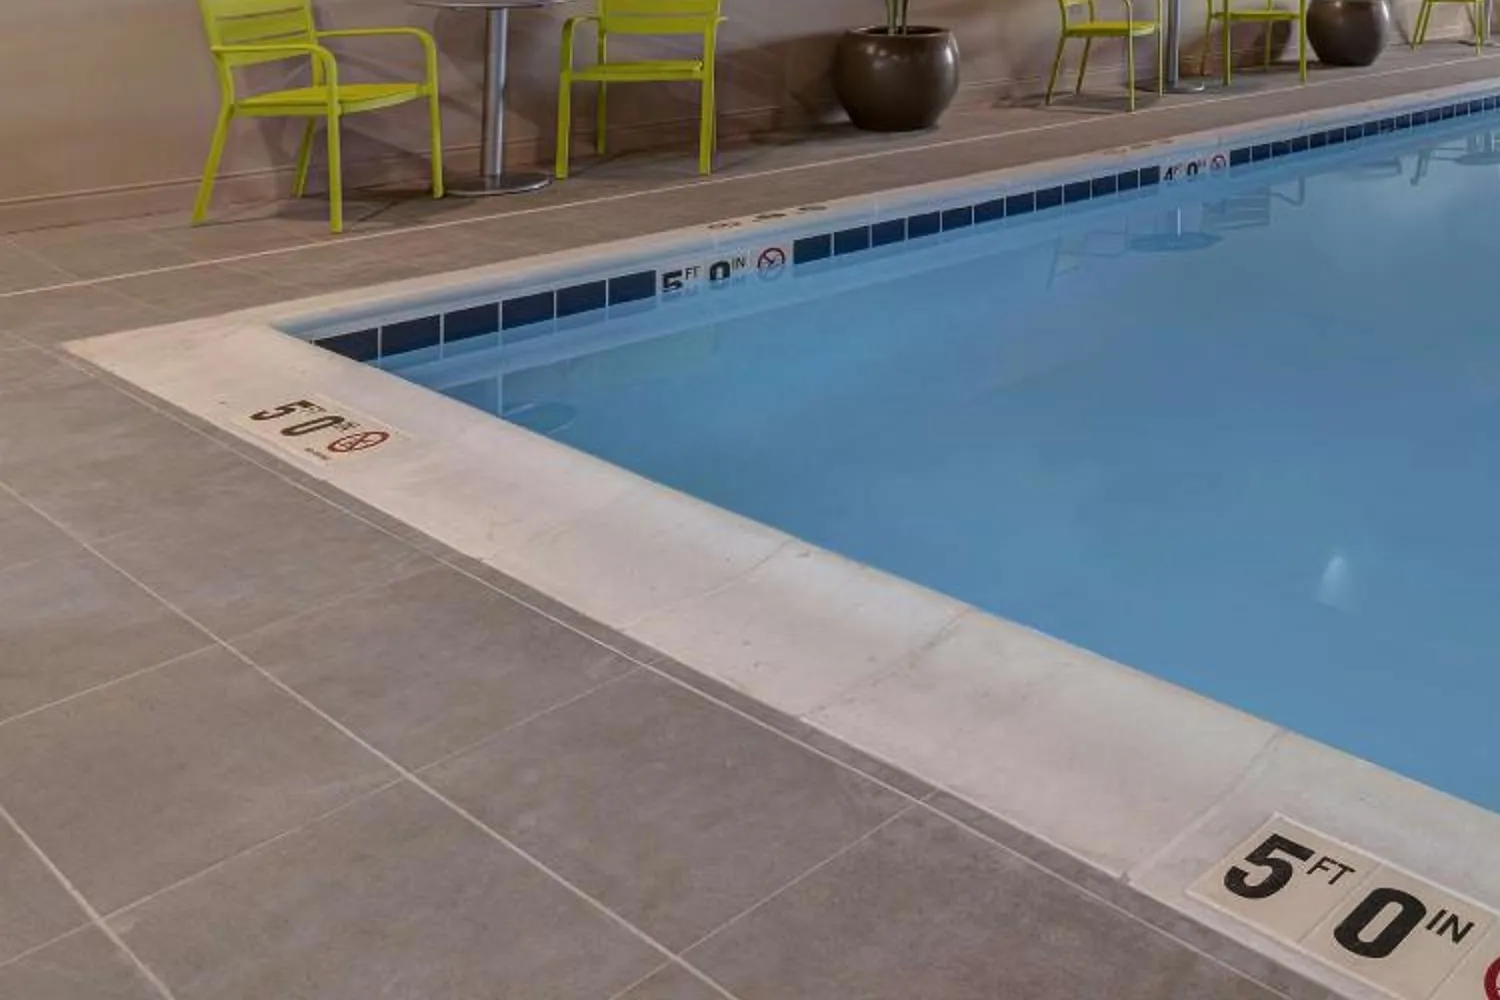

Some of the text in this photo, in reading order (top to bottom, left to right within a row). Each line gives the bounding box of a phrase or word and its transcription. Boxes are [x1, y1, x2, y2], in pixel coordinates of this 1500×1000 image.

[661, 269, 683, 293] 5
[250, 400, 313, 420] 5
[281, 416, 344, 436] 0
[1223, 833, 1475, 959] 5 FT 0 IN
